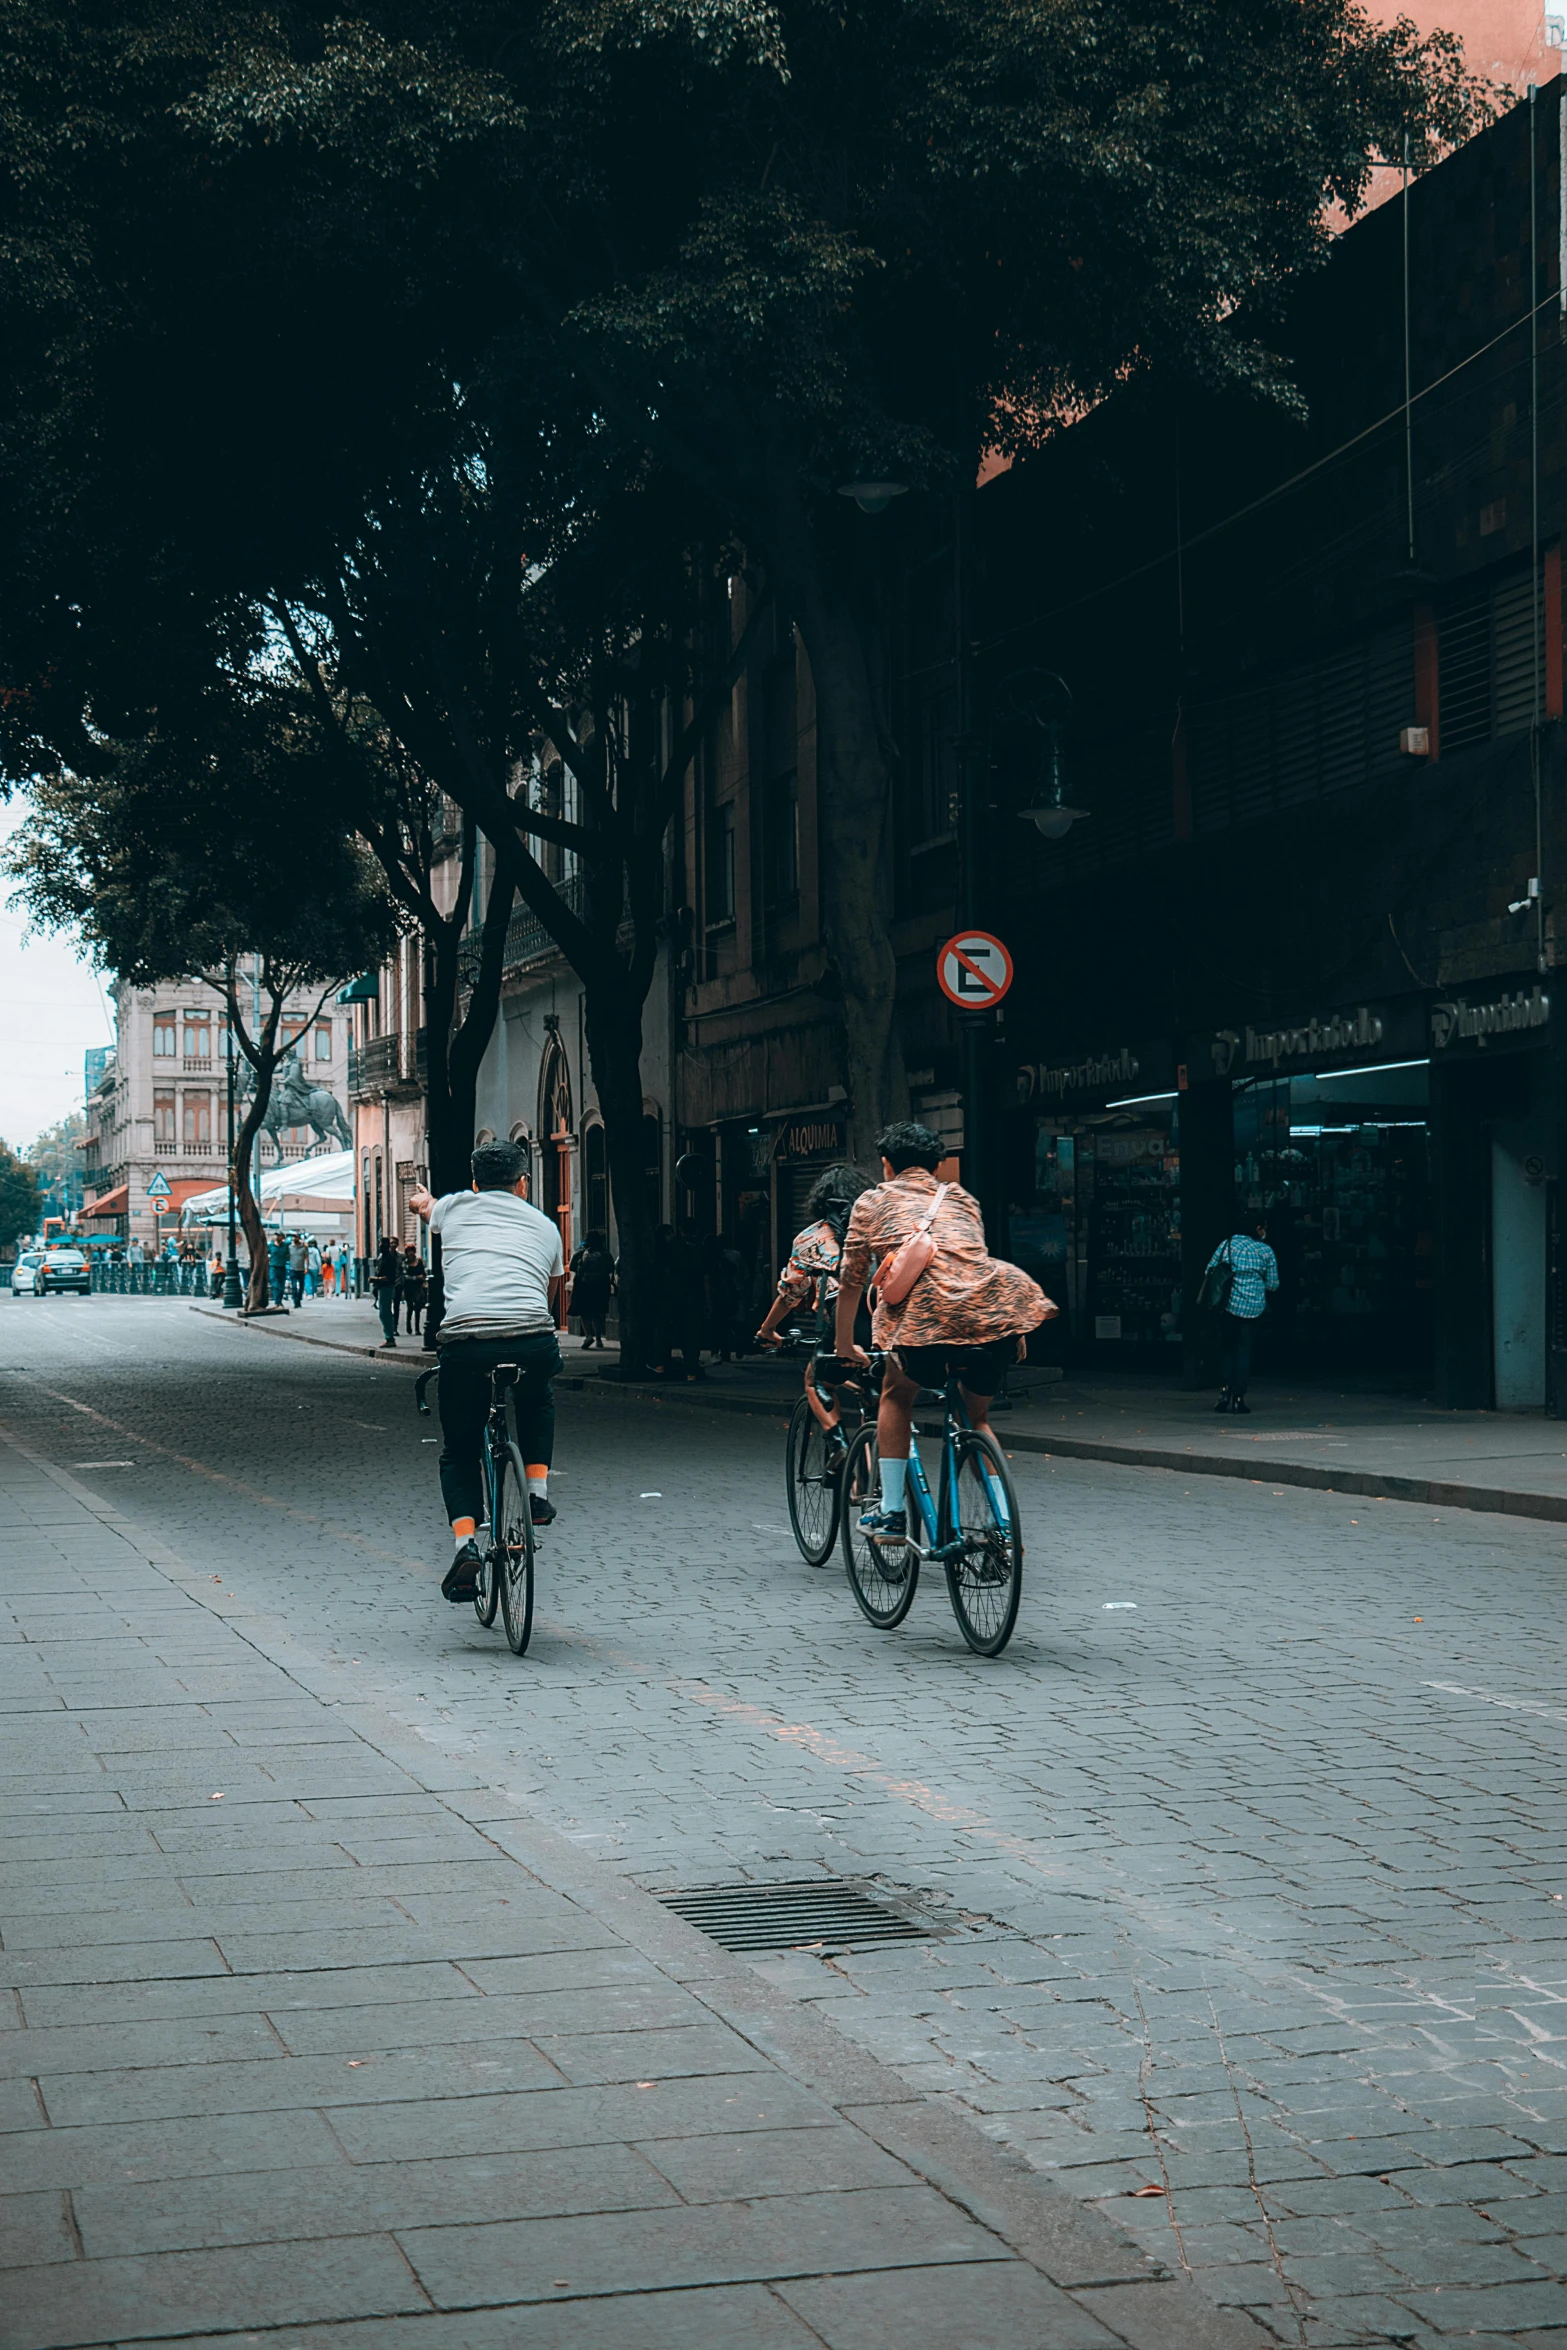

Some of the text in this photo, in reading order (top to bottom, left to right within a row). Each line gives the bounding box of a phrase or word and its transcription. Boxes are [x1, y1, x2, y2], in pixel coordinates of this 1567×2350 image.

[958, 949, 990, 992] E
[1245, 1008, 1382, 1068] Importatodo
[1039, 1048, 1139, 1100] Importatodo
[788, 1123, 838, 1156] ALQUIMIA
